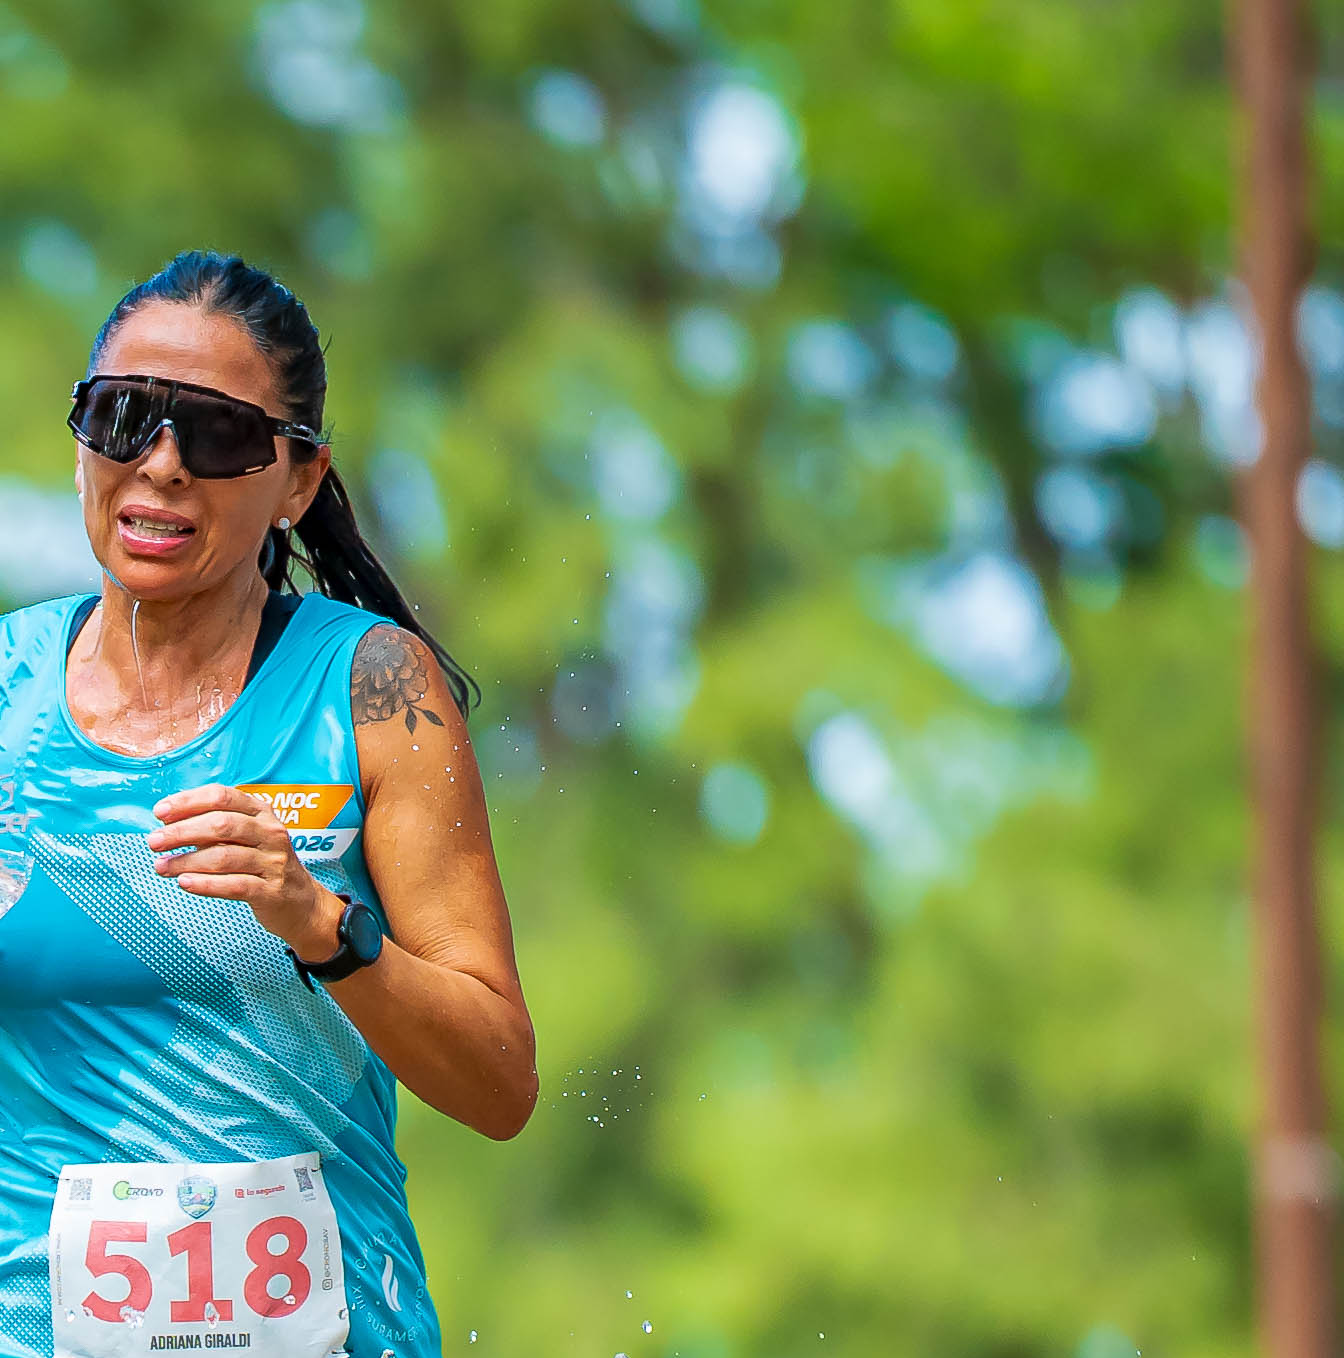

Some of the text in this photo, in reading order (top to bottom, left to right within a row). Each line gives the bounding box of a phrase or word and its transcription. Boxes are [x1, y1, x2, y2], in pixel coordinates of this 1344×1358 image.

[272, 792, 320, 809] NOC
[289, 835, 336, 852] 026
[81, 1215, 311, 1323] 518
[150, 1333, 251, 1350] ADRIANA GIRALDI
